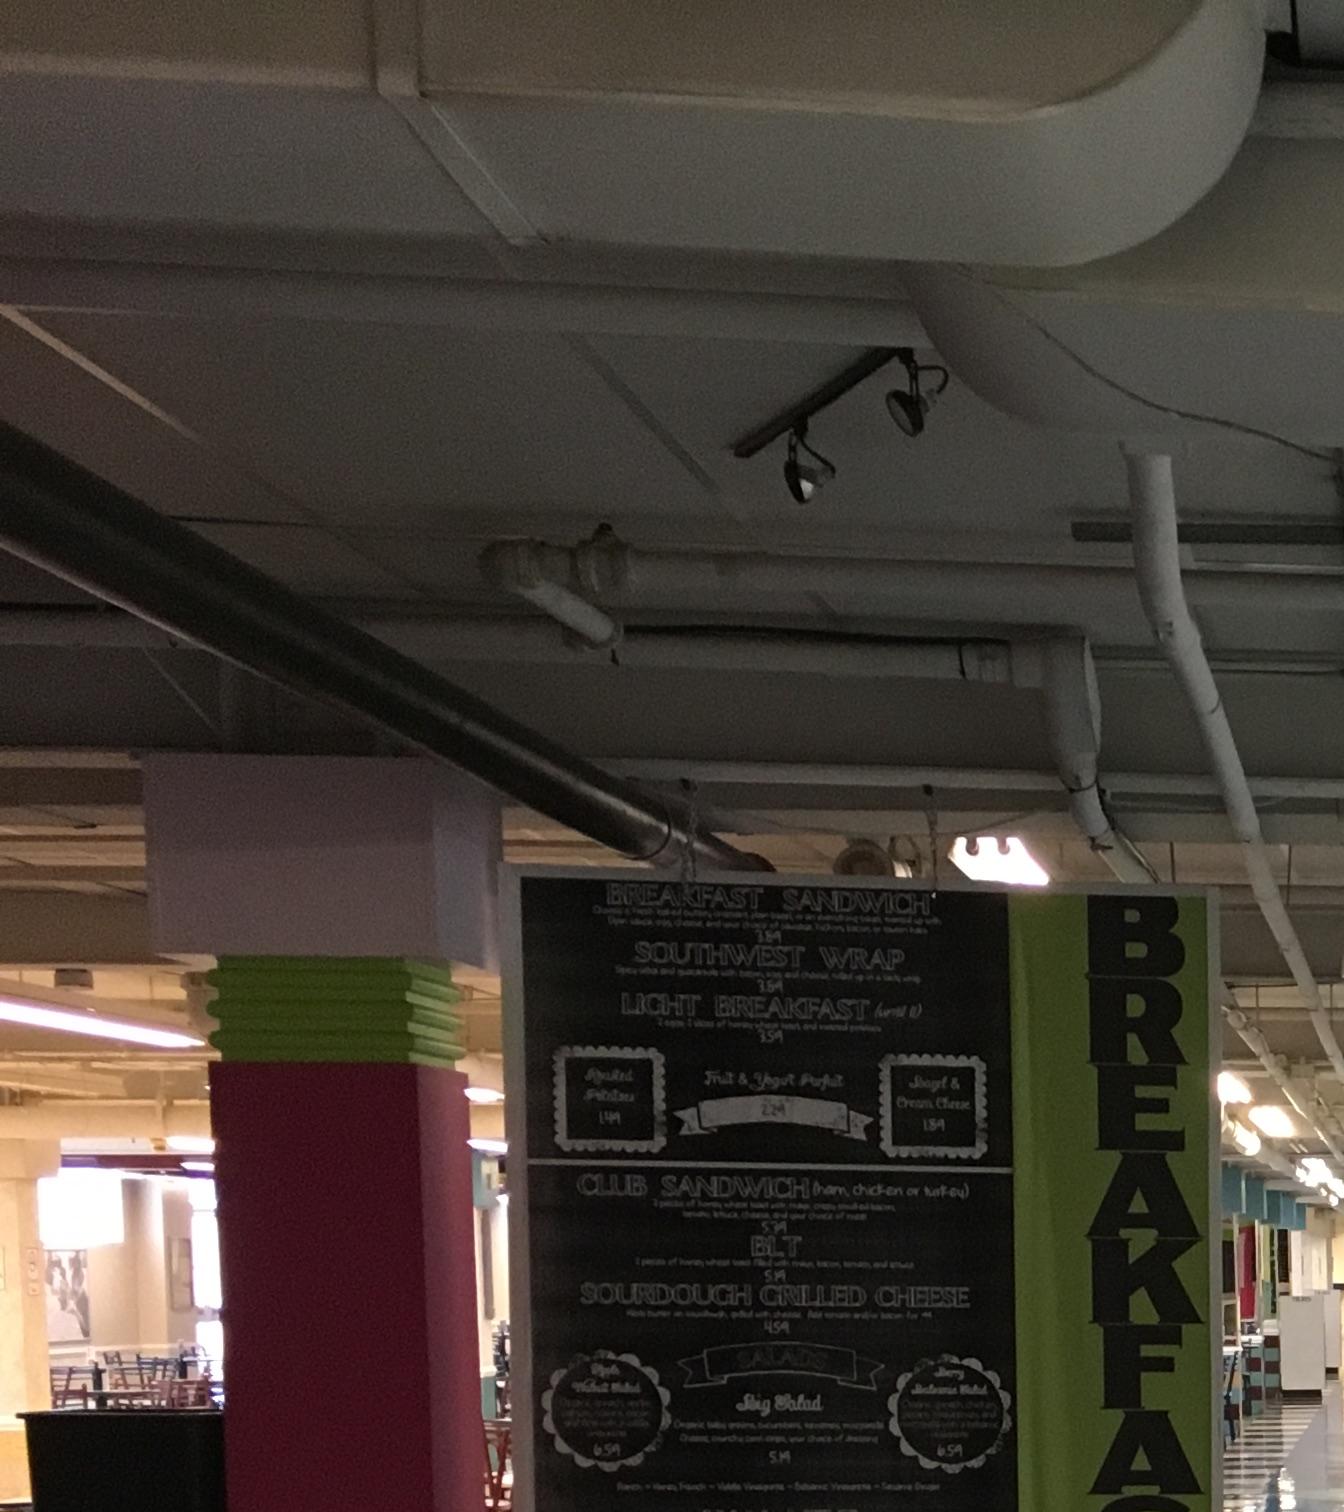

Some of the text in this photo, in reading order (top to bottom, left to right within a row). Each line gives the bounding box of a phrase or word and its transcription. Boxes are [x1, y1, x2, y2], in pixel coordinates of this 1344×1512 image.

[607, 883, 764, 910] BREAKFAST
[783, 889, 930, 915] SANDWICH
[634, 941, 905, 970] SOUTHWEST WRAP
[621, 992, 701, 1016] LIGHT
[714, 994, 870, 1020] BREAKFAST
[576, 1173, 648, 1196] CLUB
[661, 1175, 810, 1199] SANDWICH
[852, 1182, 903, 1197] chicken
[906, 1187, 919, 1196] or
[751, 1235, 802, 1257] BLT
[580, 1282, 971, 1308] SOURDOUGH GRILLED CHEESE
